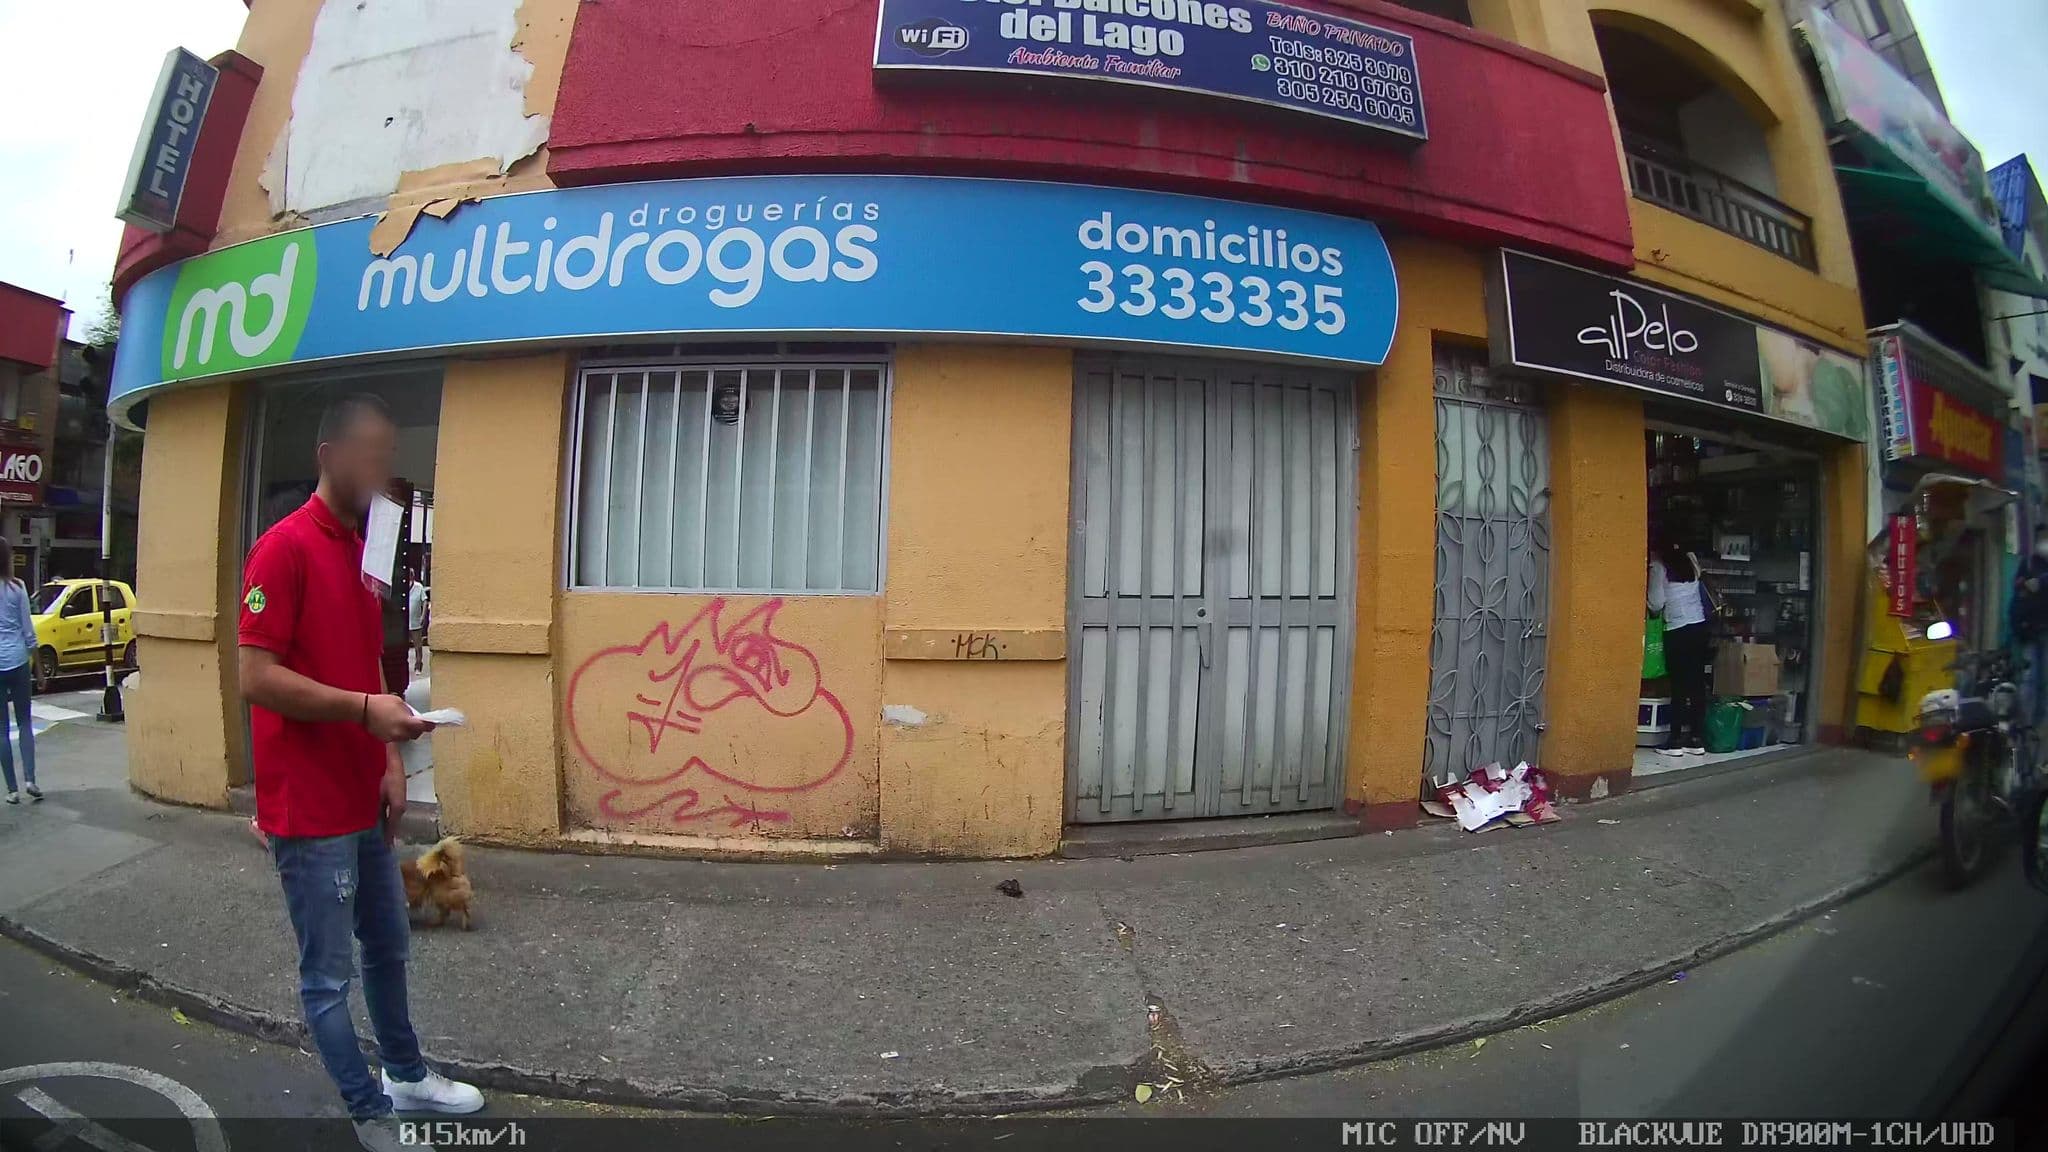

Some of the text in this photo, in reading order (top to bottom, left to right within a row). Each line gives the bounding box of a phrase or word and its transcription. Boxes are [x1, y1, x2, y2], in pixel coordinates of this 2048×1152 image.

[1001, 9, 1184, 56] del Lago
[1267, 12, 1404, 57] BAÑO PRIVADO
[1269, 36, 1322, 63] Tels:
[1325, 48, 1362, 71] 325
[1008, 47, 1181, 79] Ambiente Familiar
[1274, 57, 1413, 105] 310 218 6766
[1277, 78, 1415, 126] 305 254 6045
[150, 72, 204, 198] HOTEL
[629, 196, 879, 229] droguerías
[358, 211, 879, 311] multidrogas
[1078, 211, 1343, 276] domicilios
[1077, 261, 1345, 335] 3333335
[1605, 359, 1654, 380] Distribuidora
[1655, 372, 1665, 383] de
